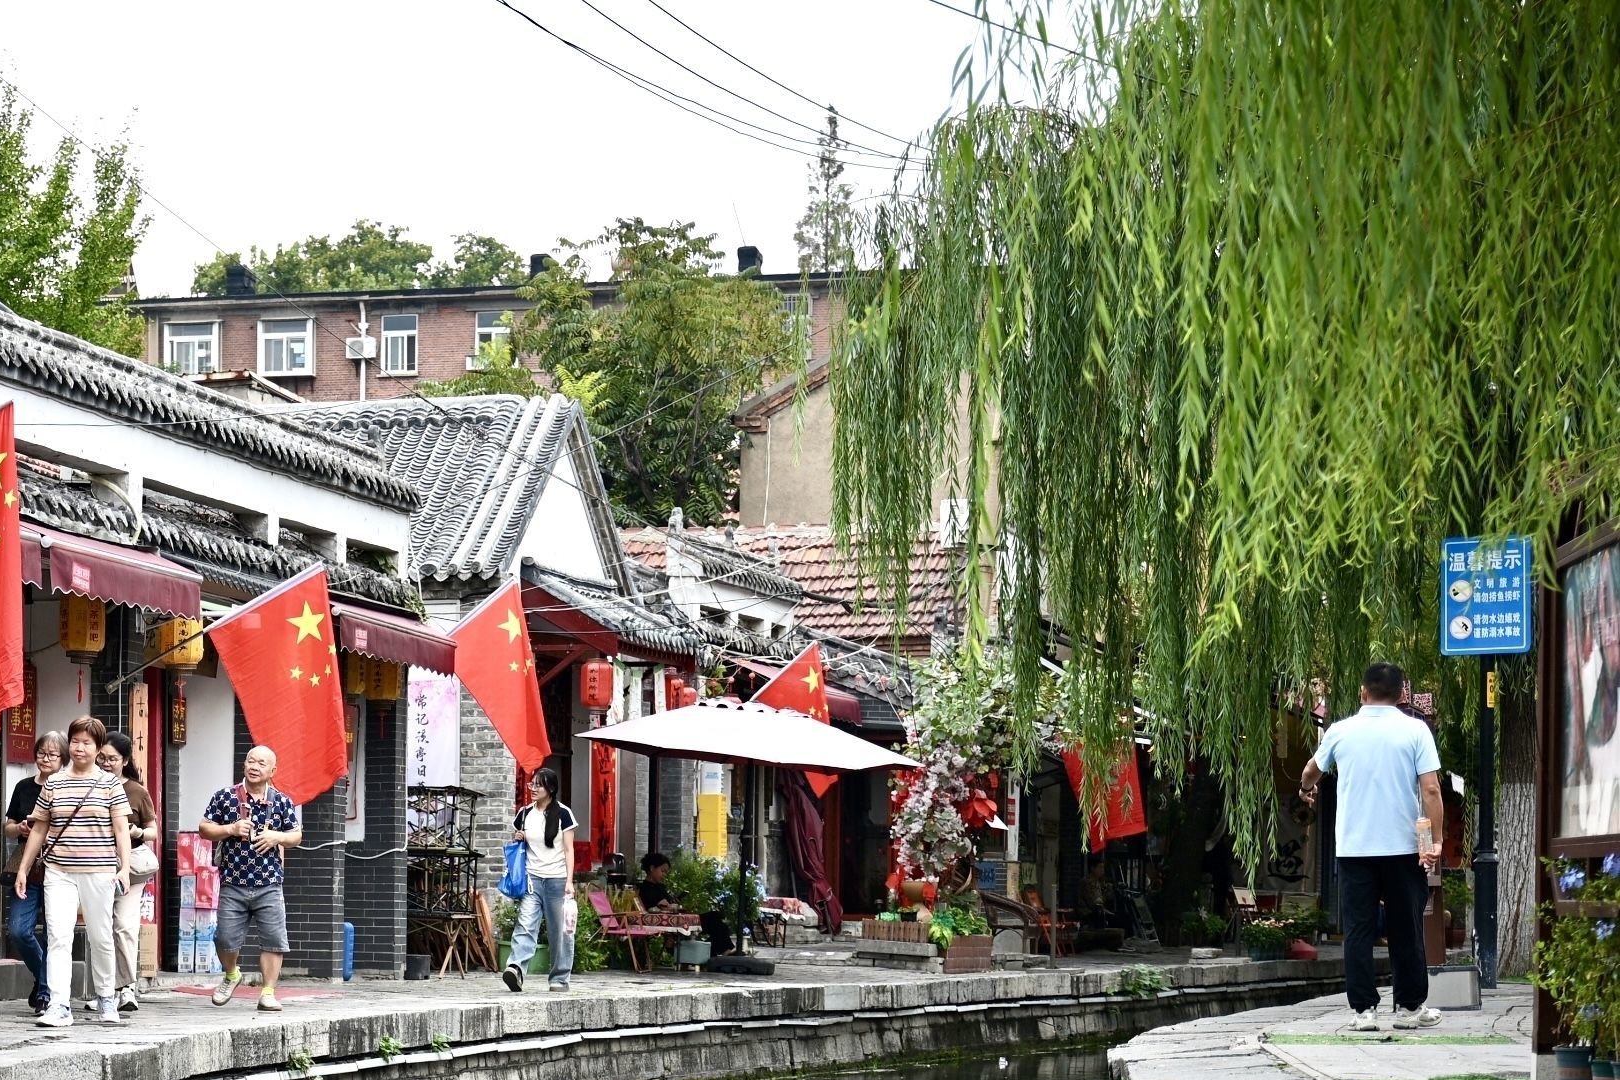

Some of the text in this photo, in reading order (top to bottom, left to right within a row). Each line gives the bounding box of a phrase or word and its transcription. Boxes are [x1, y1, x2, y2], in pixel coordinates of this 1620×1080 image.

[1449, 550, 1521, 571] 温馨提示
[1474, 577, 1520, 588] 文明旅游
[1473, 613, 1520, 625] 请勿水边嬉戏
[1473, 626, 1520, 638] 谨防溺水事故
